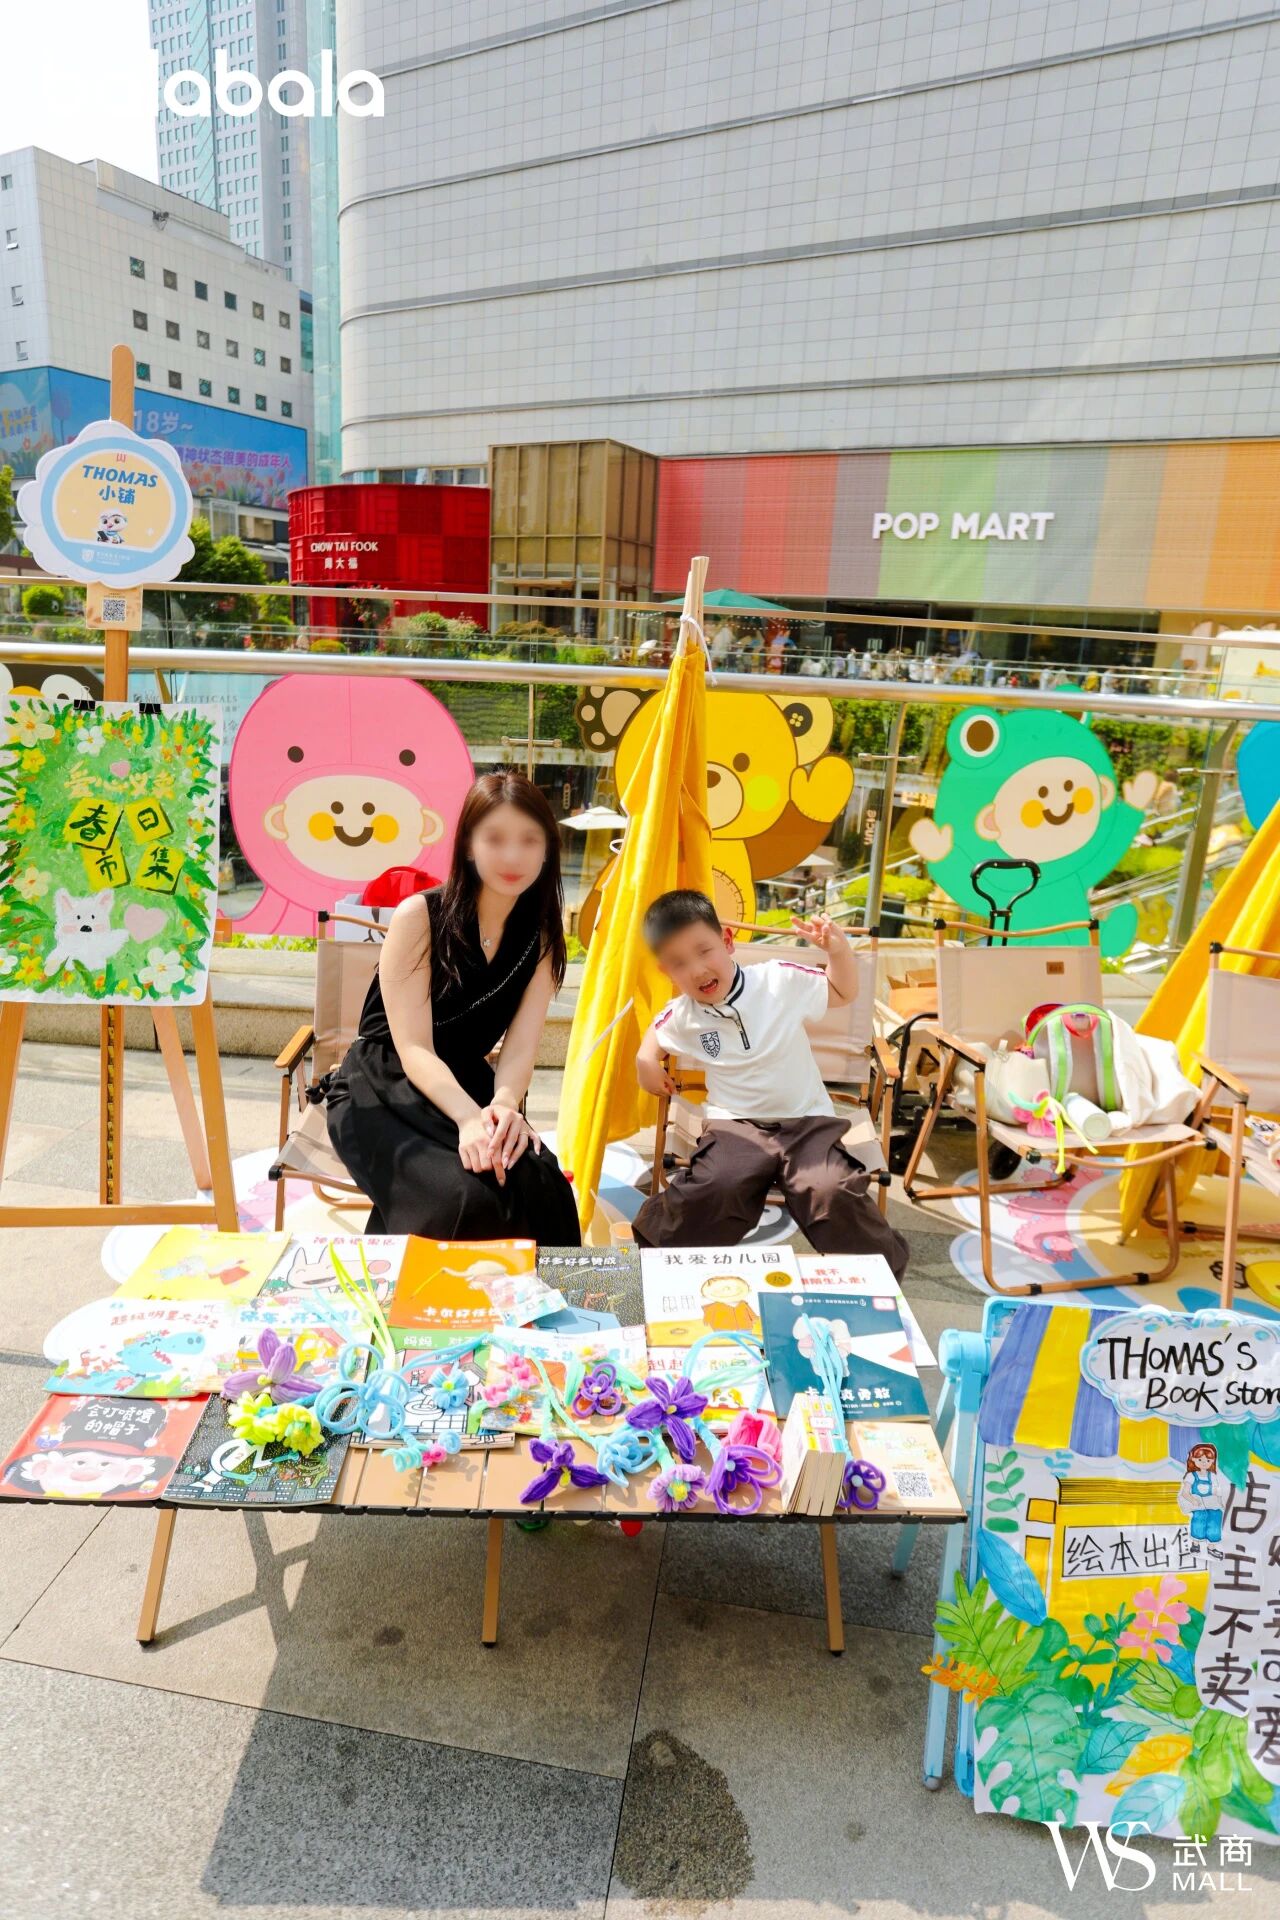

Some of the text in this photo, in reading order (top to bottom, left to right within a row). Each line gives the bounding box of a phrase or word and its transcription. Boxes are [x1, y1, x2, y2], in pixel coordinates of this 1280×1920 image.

[82, 464, 159, 488] THOMAS
[99, 485, 136, 505] 小铺
[872, 512, 1055, 540] POP MART
[310, 541, 379, 553] CHOW TAI FOOK
[664, 1252, 782, 1265] 我爱幼儿园
[1145, 1377, 1219, 1414] Book
[84, 1419, 140, 1436] 的帽子
